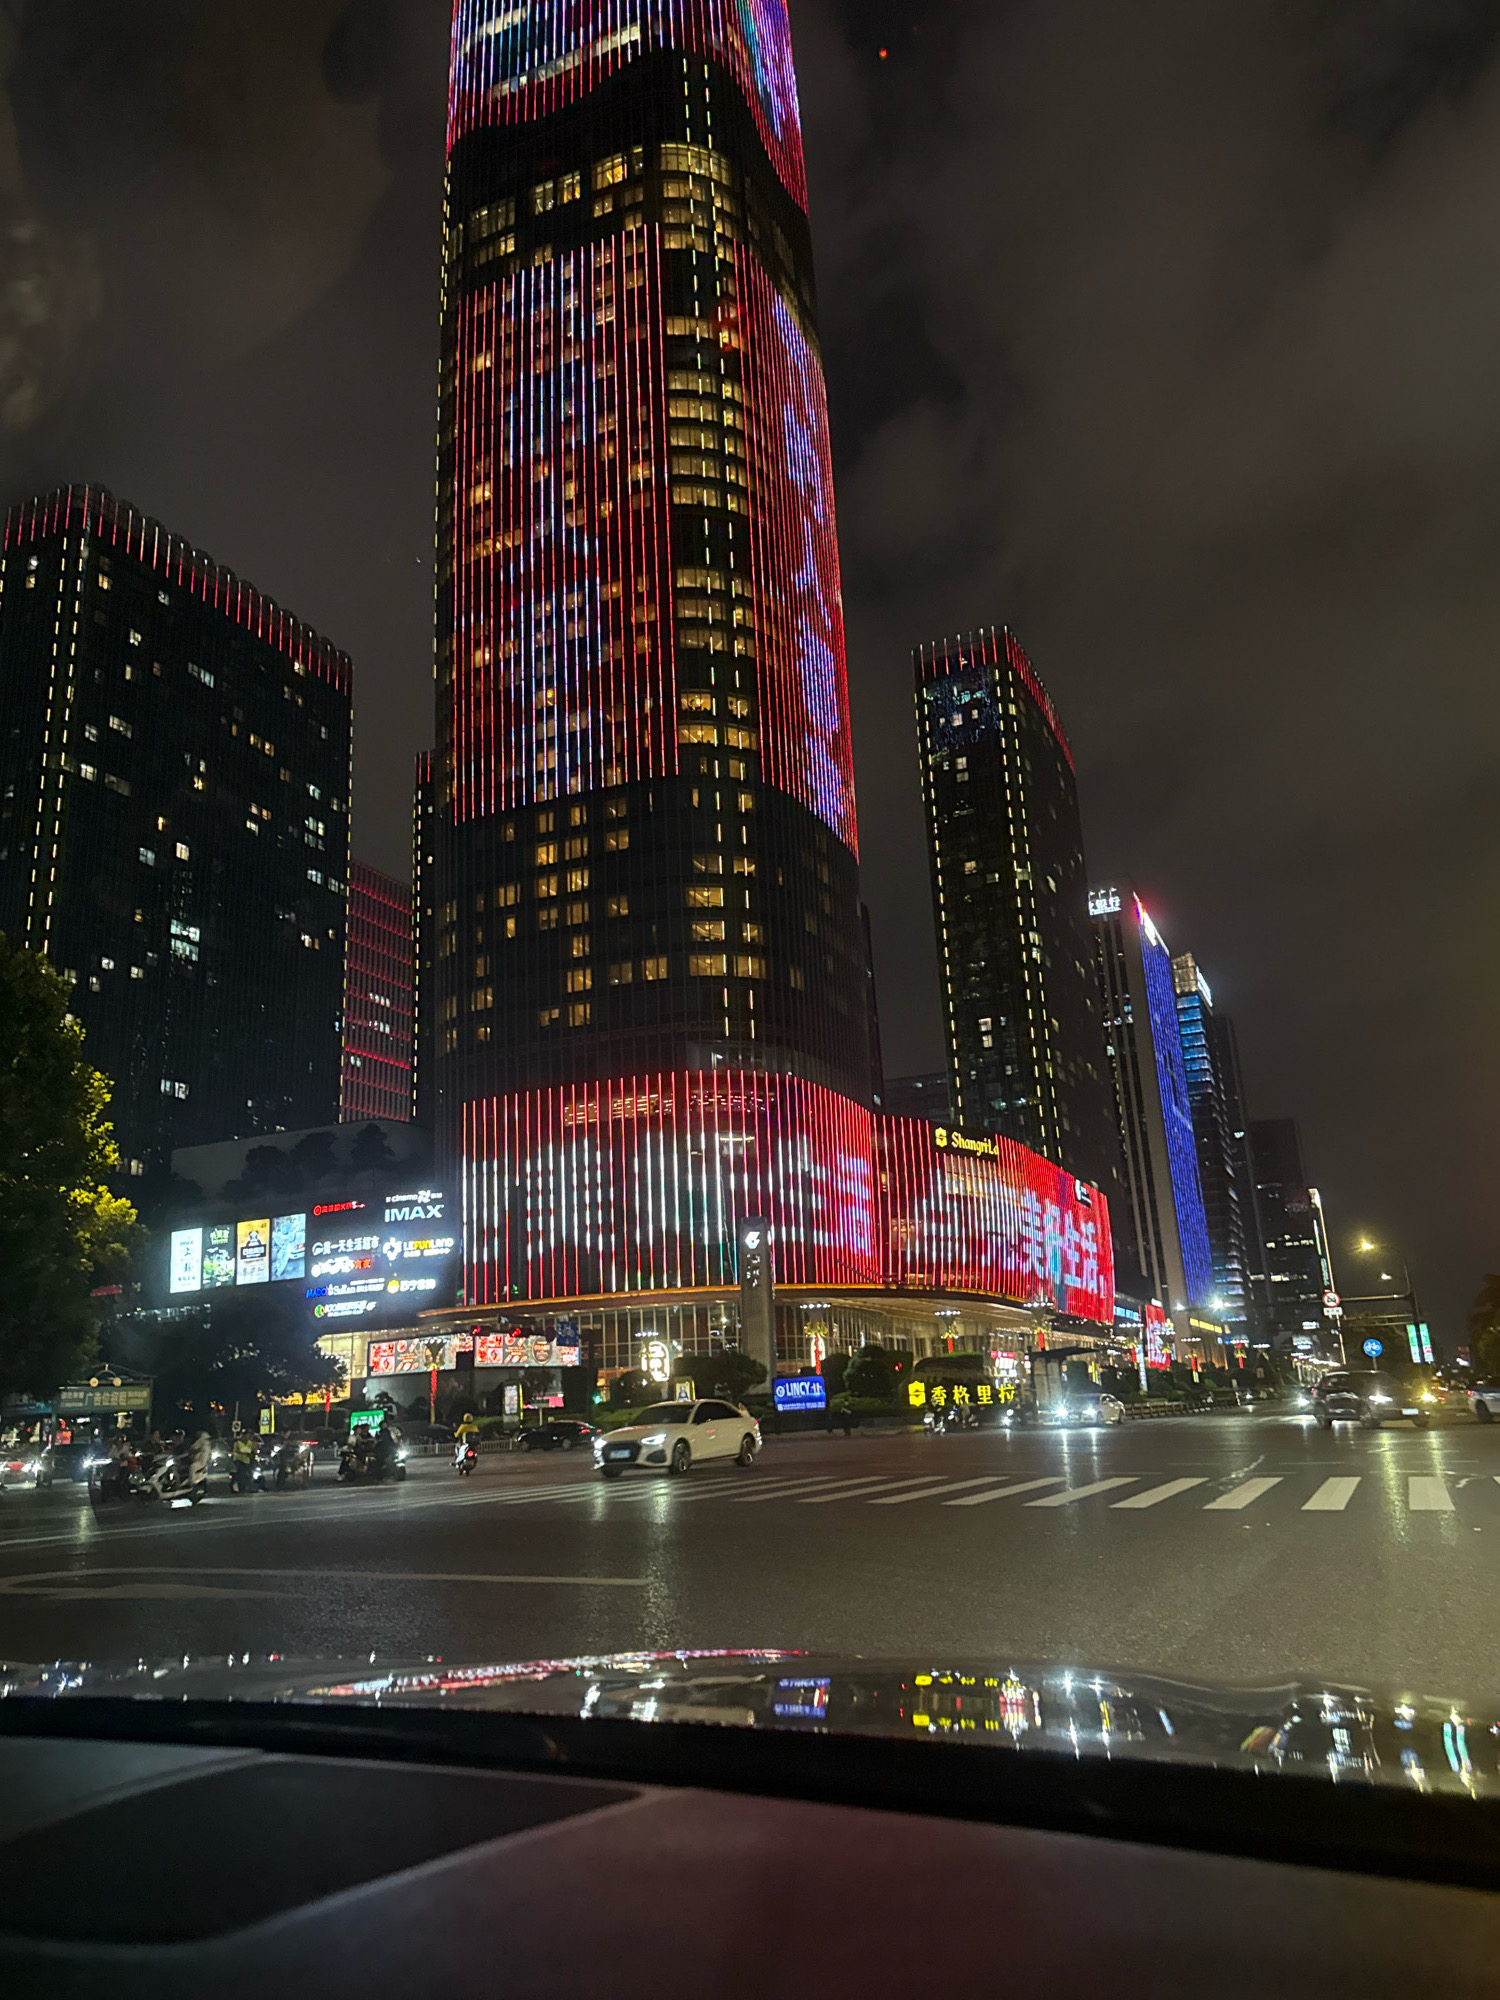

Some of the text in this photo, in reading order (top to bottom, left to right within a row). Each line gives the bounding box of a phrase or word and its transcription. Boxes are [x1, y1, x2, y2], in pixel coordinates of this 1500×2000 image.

[385, 1205, 443, 1222] IMAX
[931, 1384, 1016, 1406] 香格里拉
